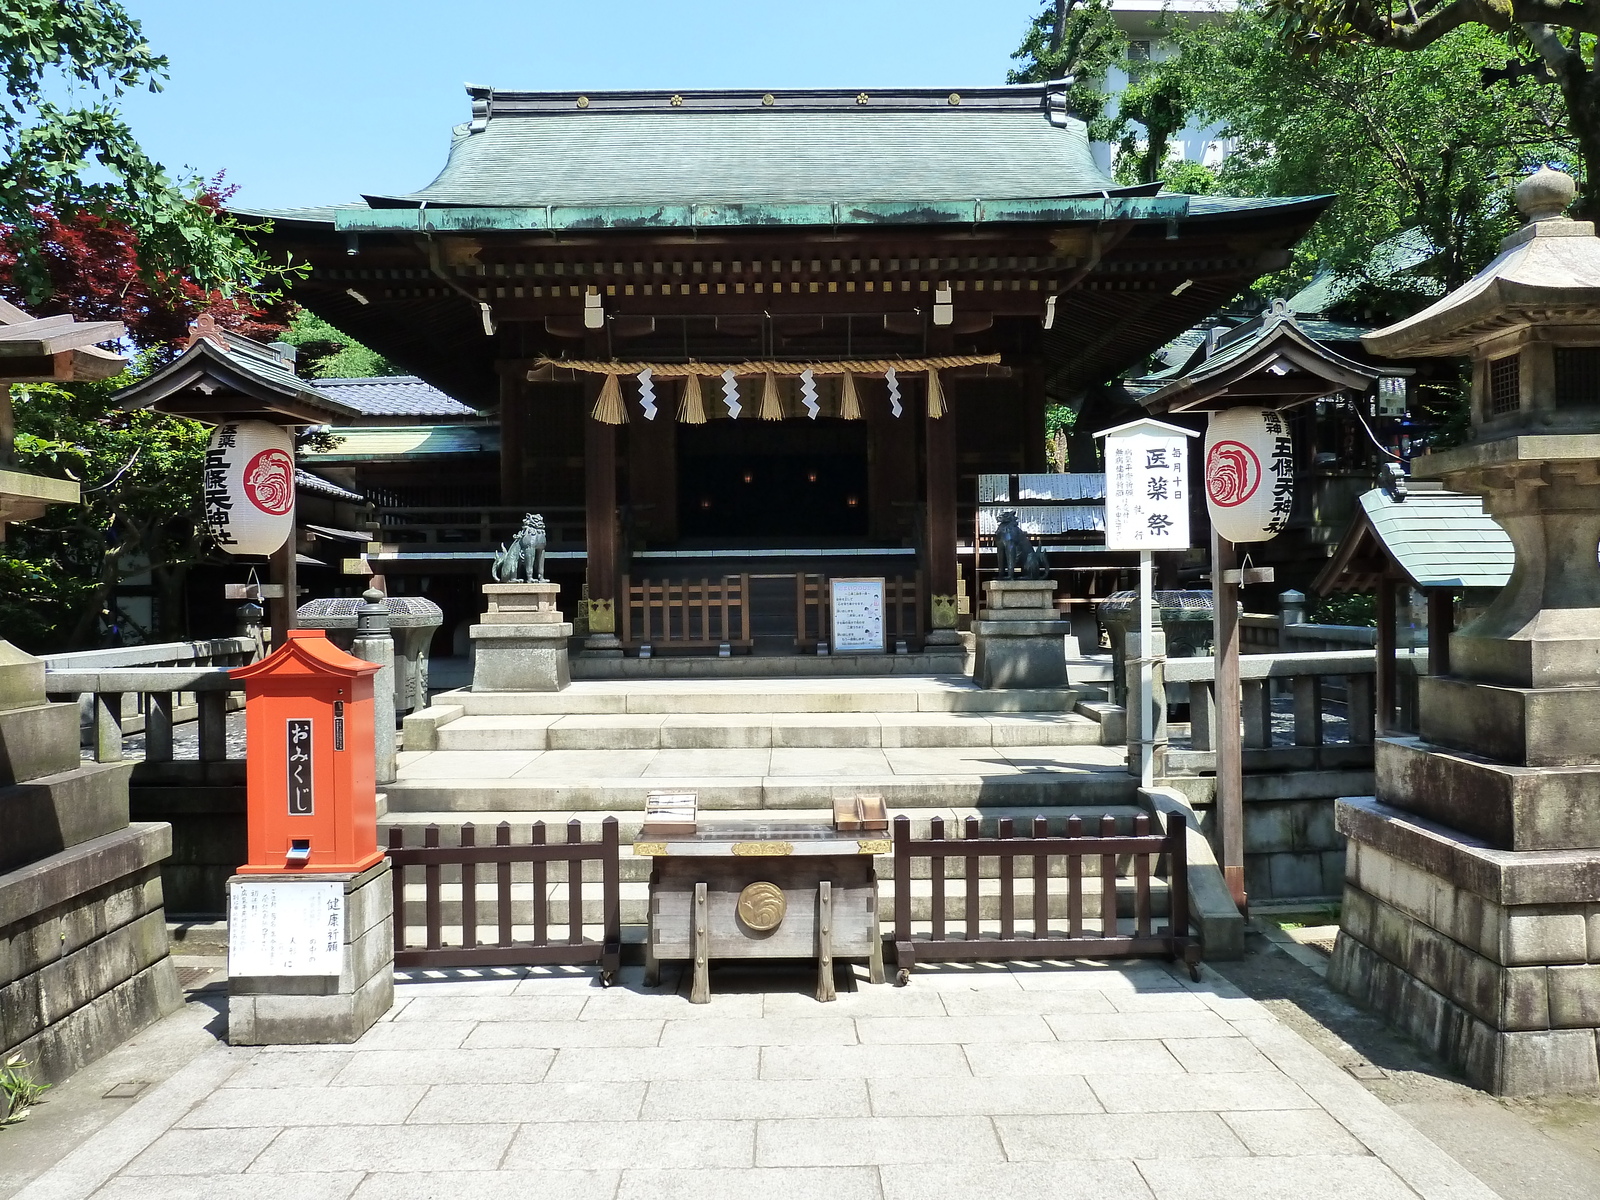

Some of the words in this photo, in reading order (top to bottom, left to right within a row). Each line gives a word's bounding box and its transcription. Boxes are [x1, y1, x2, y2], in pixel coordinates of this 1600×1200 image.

[1145, 447, 1174, 537] 医薬祭
[1172, 447, 1182, 500] 毎月十日
[290, 723, 310, 811] おみくじ
[326, 897, 341, 952] 健康祈願
